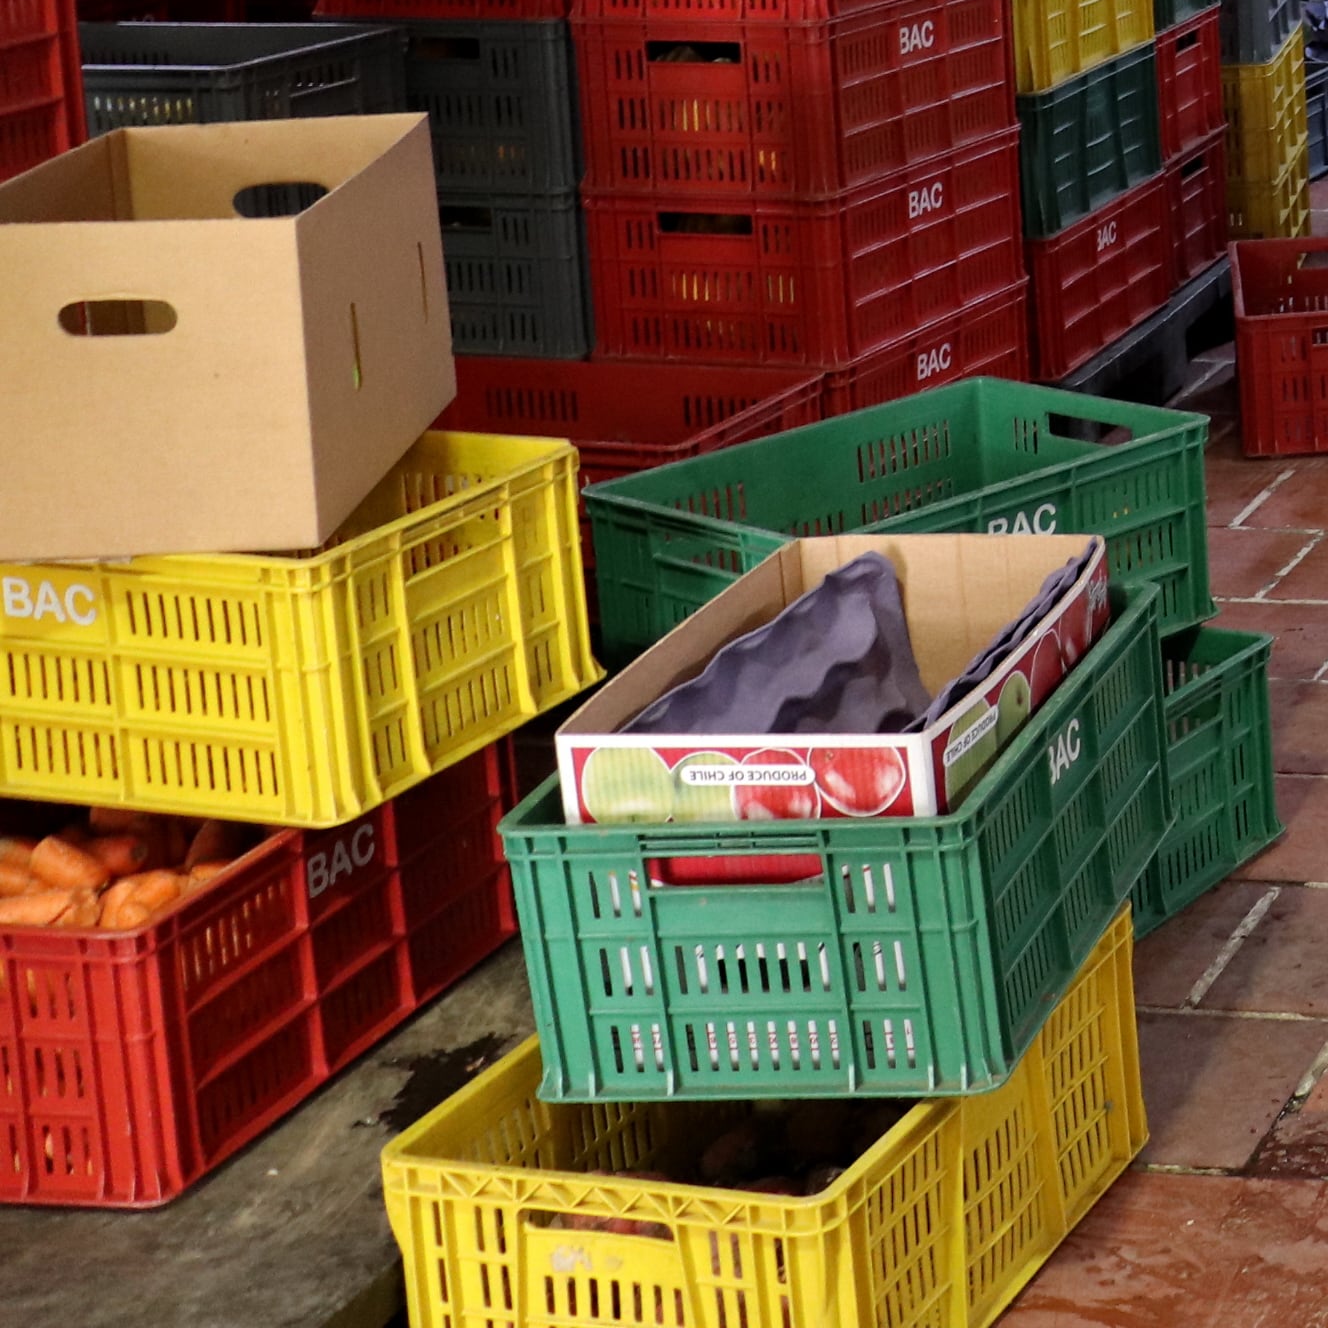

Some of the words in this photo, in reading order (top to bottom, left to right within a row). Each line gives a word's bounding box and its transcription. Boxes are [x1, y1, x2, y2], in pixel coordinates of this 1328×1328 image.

[899, 20, 934, 55] BAC
[908, 182, 943, 219] BAC
[917, 343, 951, 380] BAC
[2, 577, 96, 626] BAC
[690, 770, 725, 781] CHILE
[729, 770, 745, 781] OF
[748, 770, 807, 781] PRODUCE
[307, 824, 375, 898] BAC
